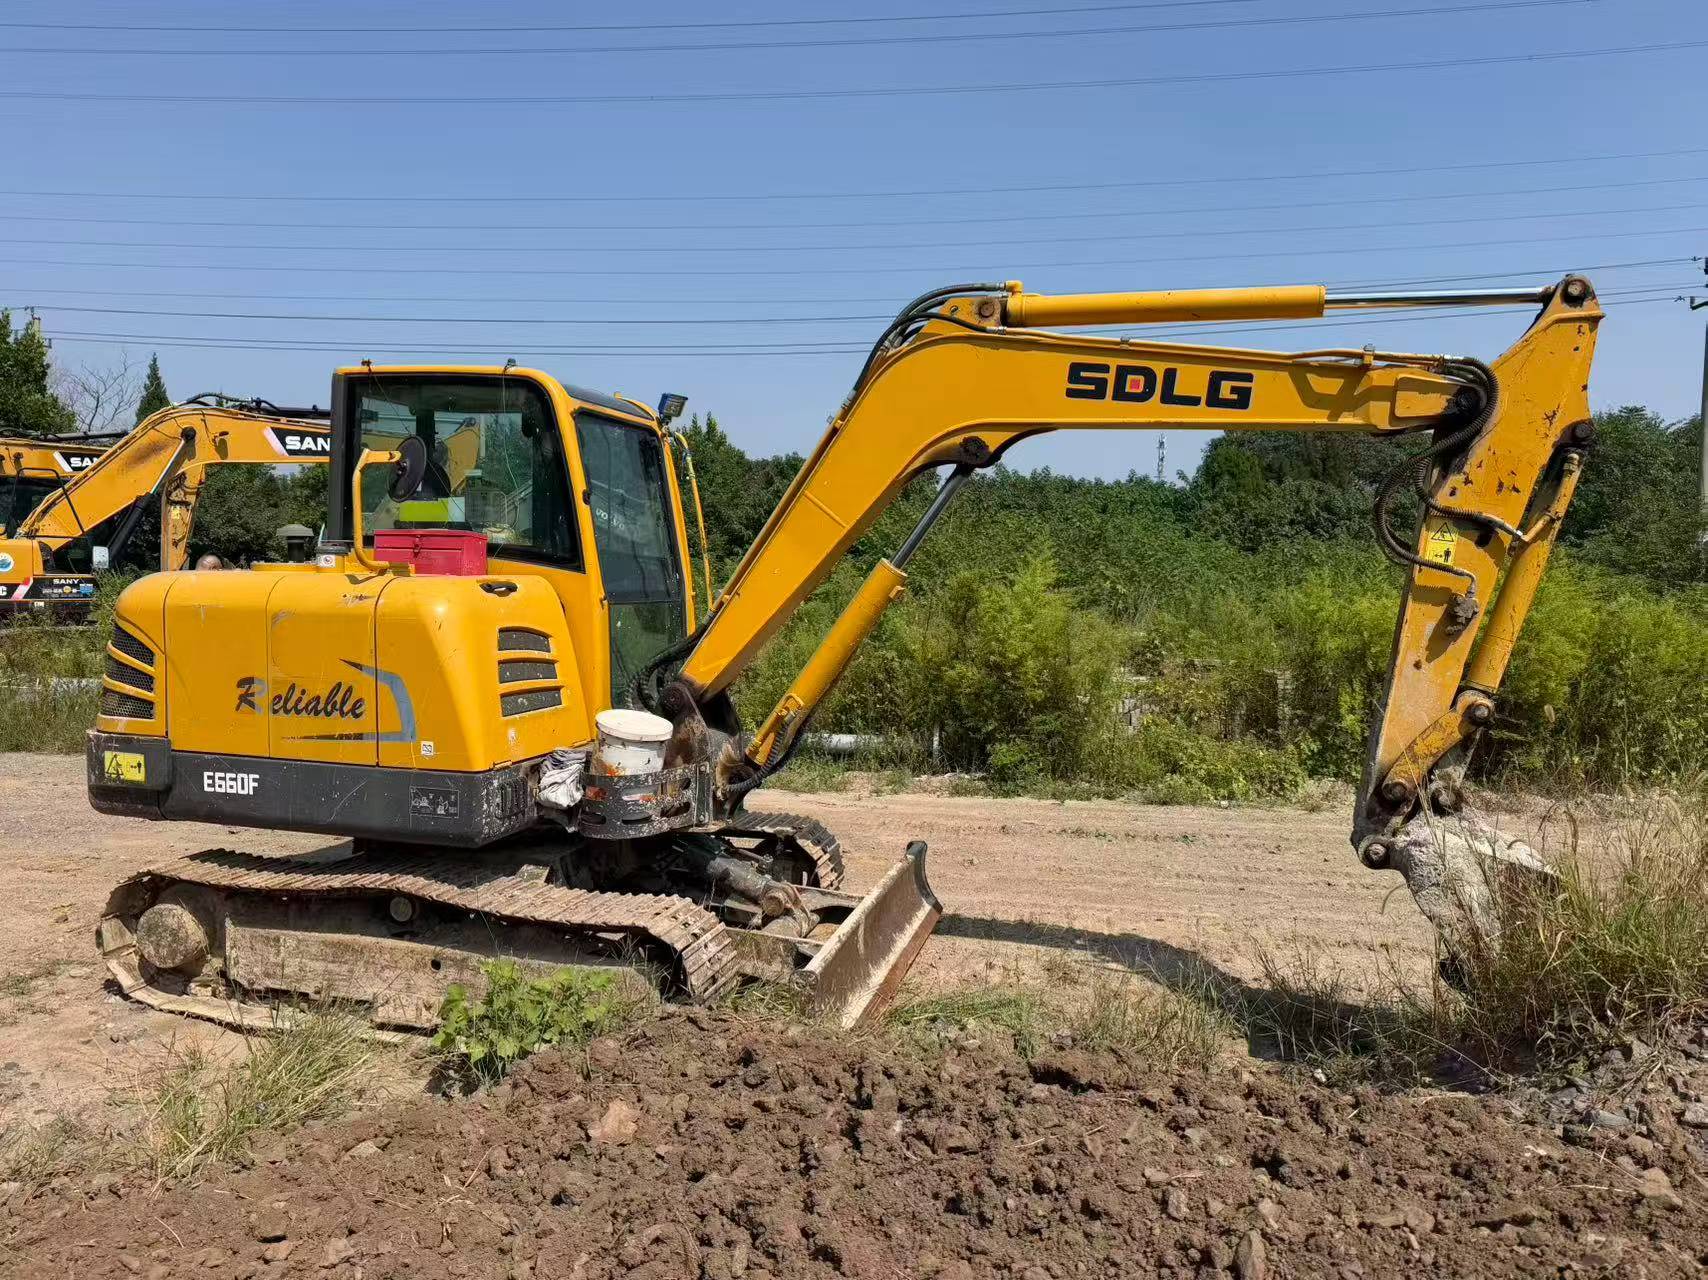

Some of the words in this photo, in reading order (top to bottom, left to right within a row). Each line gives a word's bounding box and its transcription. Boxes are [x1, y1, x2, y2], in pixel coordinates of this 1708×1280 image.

[1065, 362, 1254, 410] SDLG
[235, 676, 366, 719] Reliable
[203, 771, 260, 795] E660F
